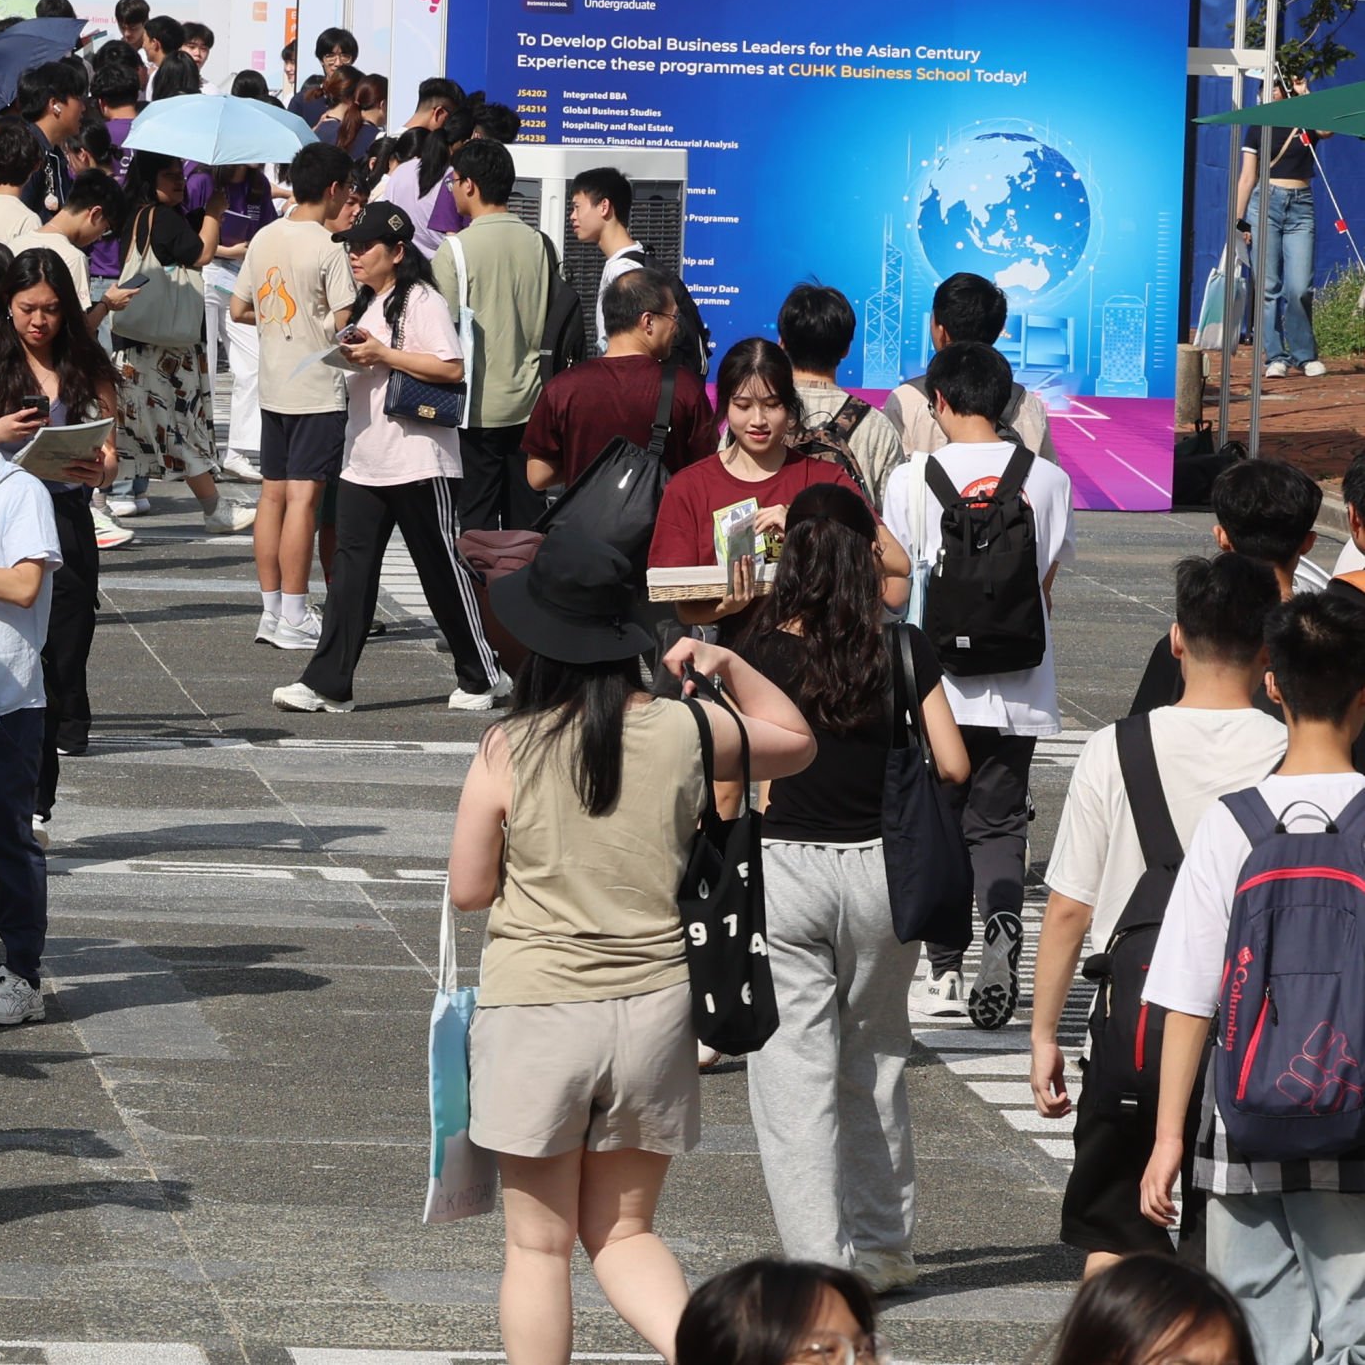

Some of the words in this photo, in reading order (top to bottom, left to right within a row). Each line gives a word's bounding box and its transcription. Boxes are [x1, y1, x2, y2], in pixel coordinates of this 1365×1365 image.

[518, 32, 537, 46] To
[541, 33, 607, 51] Develop
[611, 35, 662, 51] Global
[666, 37, 738, 53] Business
[742, 40, 806, 55] Leaders
[809, 42, 832, 56] for
[835, 43, 863, 57] the
[866, 44, 912, 59] Asian
[915, 46, 981, 63] Century
[517, 54, 606, 71] Experience
[610, 56, 656, 71] these
[660, 60, 764, 76] programmes
[768, 64, 785, 76] at
[788, 63, 837, 77] CUHK
[840, 65, 912, 80] Business
[916, 67, 971, 82] School
[975, 69, 1028, 86] Today!
[517, 89, 547, 98] JS4202
[563, 90, 609, 101] Integrated
[610, 92, 627, 101] BBA
[516, 105, 547, 113] JS4214
[563, 106, 591, 115] Global
[592, 107, 628, 116] Business
[630, 108, 662, 117] Studies
[519, 120, 546, 128] S4226
[562, 121, 608, 132] Hospitality
[610, 122, 626, 131] and
[628, 123, 646, 132] Real
[648, 124, 674, 133] Estate
[516, 134, 546, 143] JS4238
[561, 136, 605, 145] Insurance,
[607, 137, 645, 146] Financial
[646, 138, 662, 147] and
[664, 138, 702, 148] Actuarial
[703, 140, 739, 150] Analysis
[708, 187, 716, 195] in
[689, 214, 739, 224] Programme
[697, 257, 714, 266] and
[719, 285, 739, 293] Data
[693, 298, 730, 306] gramme
[689, 922, 708, 946] 9
[1226, 966, 1249, 1051] Columbia
